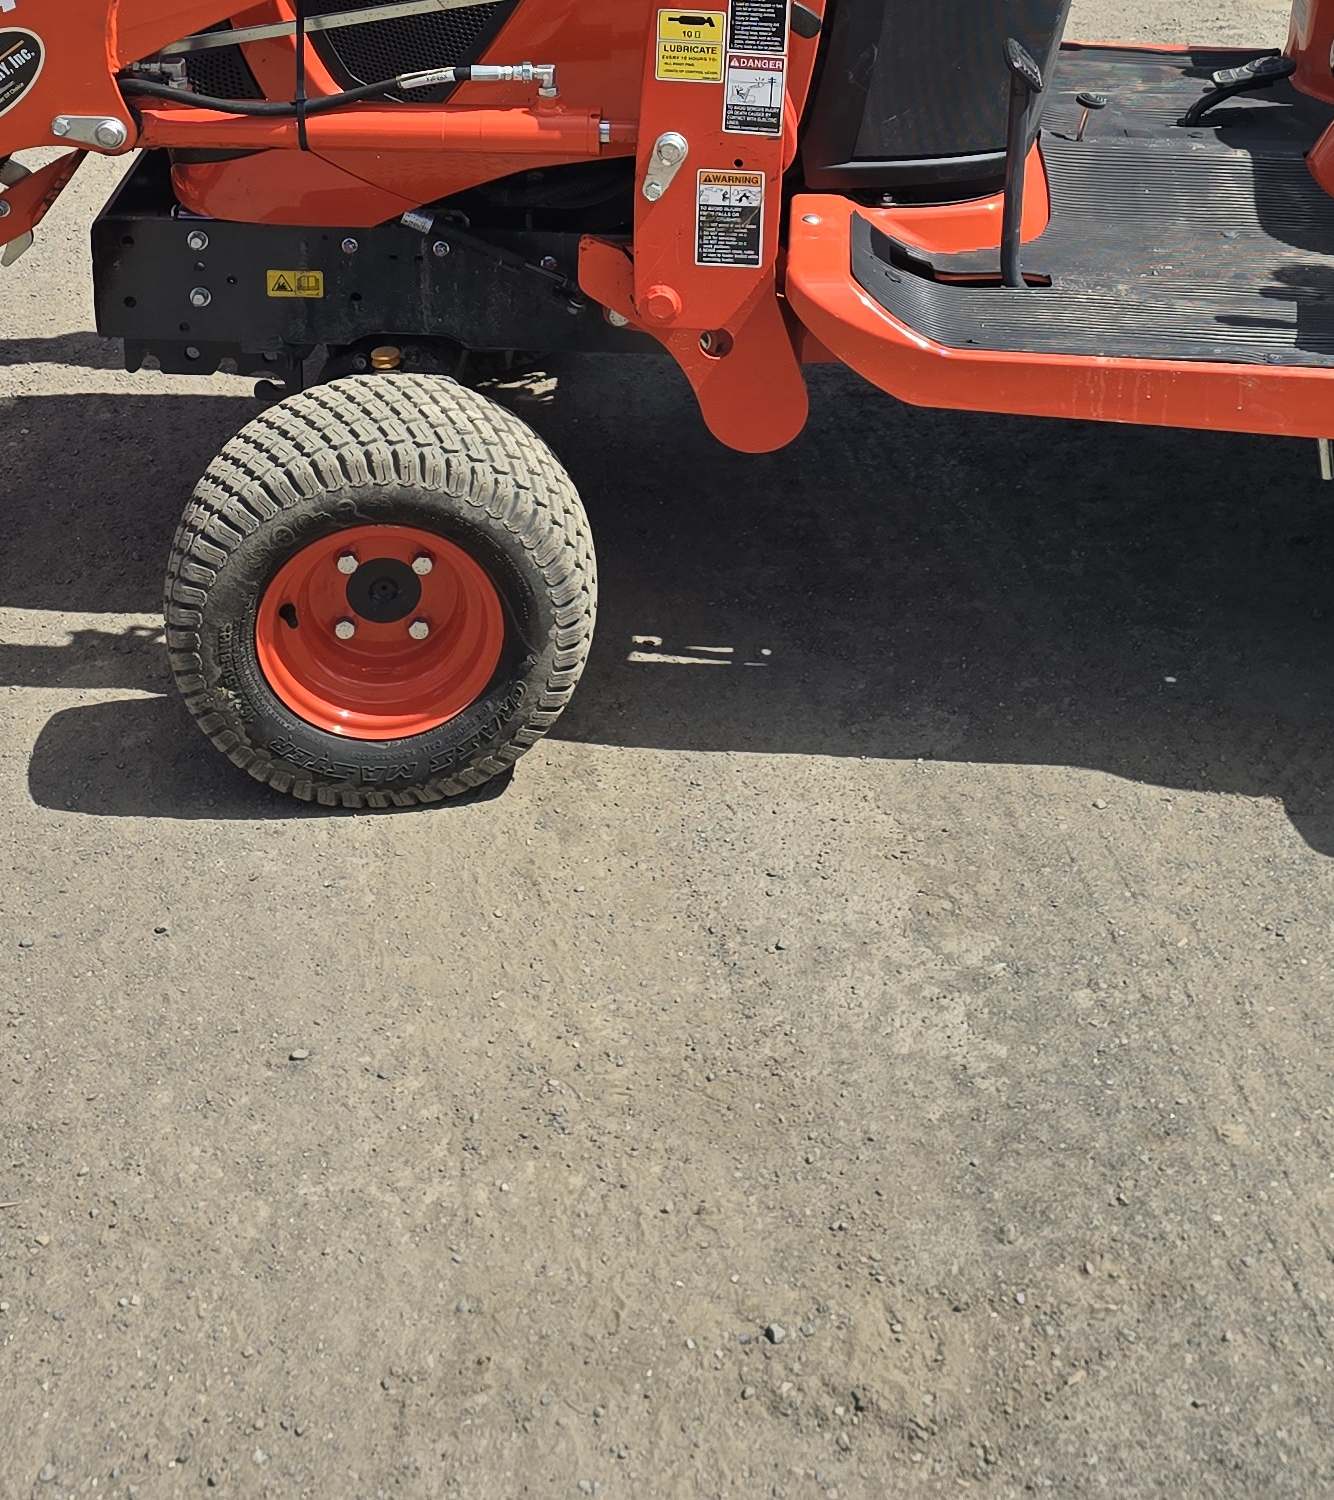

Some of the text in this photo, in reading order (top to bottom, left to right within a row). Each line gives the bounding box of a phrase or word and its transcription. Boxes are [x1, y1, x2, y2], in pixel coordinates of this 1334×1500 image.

[682, 30, 693, 38] 10
[663, 44, 718, 55] LUBRICATE
[7, 46, 37, 71] Inc.
[740, 58, 783, 70] DANGER
[712, 174, 759, 184] WARNING
[268, 734, 419, 782] MASTER
